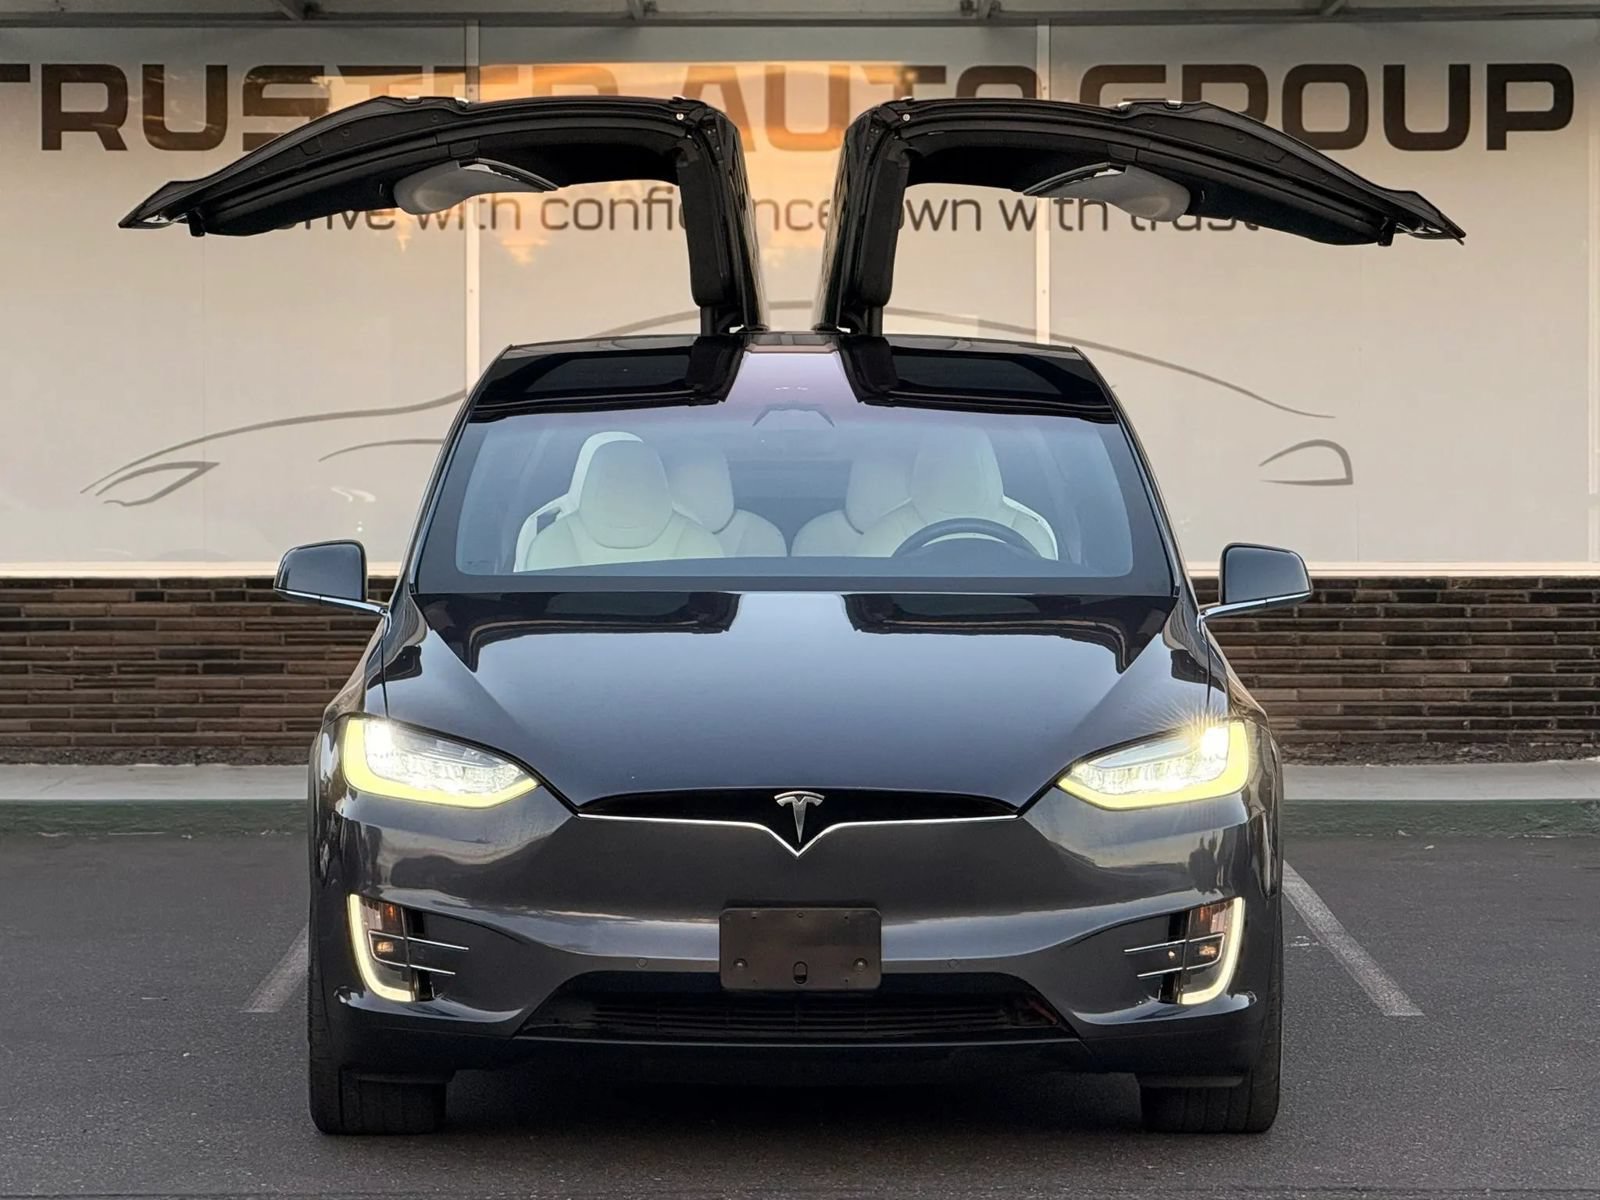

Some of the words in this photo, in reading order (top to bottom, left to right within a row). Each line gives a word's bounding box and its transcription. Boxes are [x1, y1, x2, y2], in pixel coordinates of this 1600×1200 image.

[540, 185, 831, 231] confinc
[899, 199, 982, 232] wn
[998, 197, 1108, 232] wth
